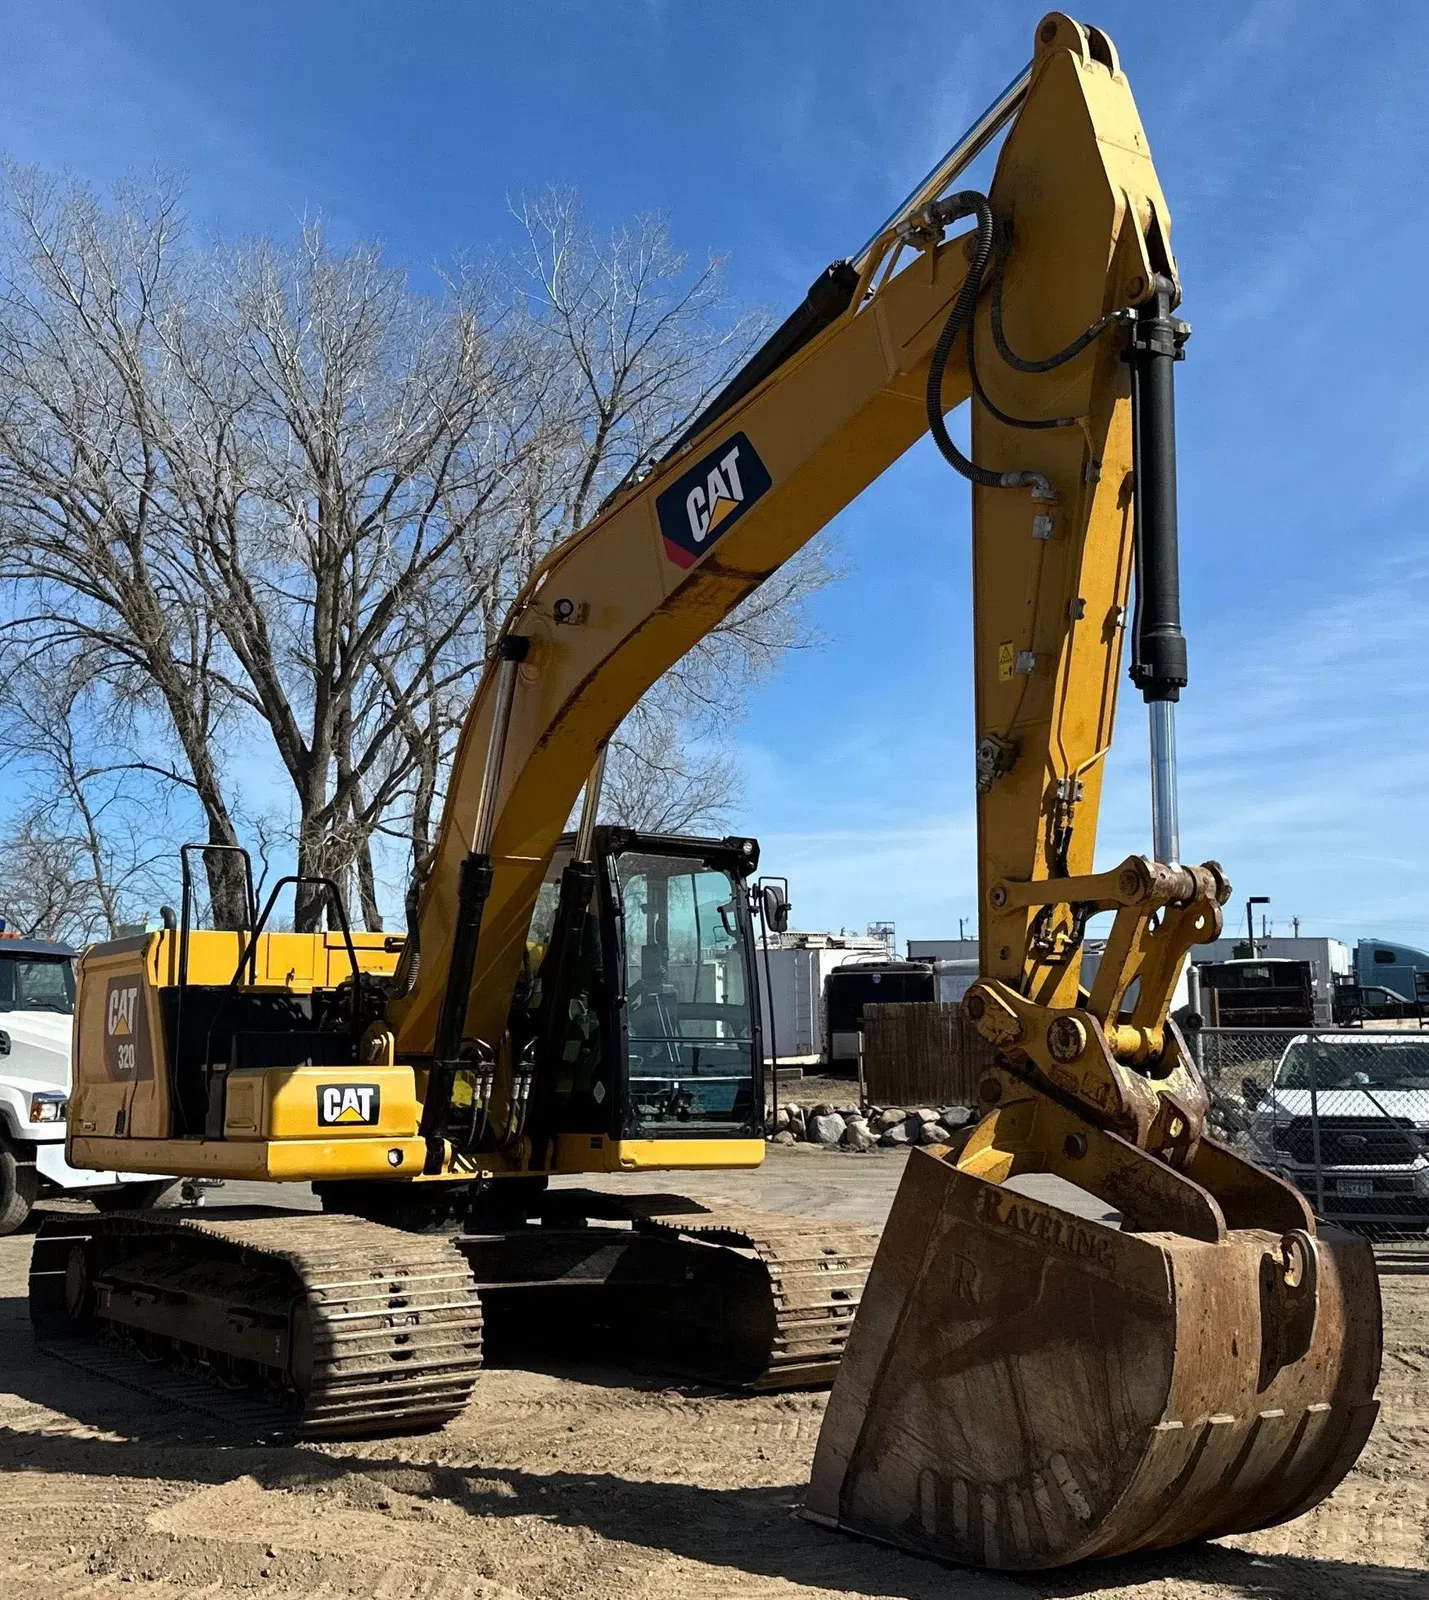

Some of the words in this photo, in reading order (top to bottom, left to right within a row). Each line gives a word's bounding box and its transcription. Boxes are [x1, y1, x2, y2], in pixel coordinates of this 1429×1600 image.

[686, 446, 744, 542] CAT
[107, 987, 138, 1036] CAT
[118, 1043, 136, 1070] 320
[323, 1087, 374, 1122] CAT
